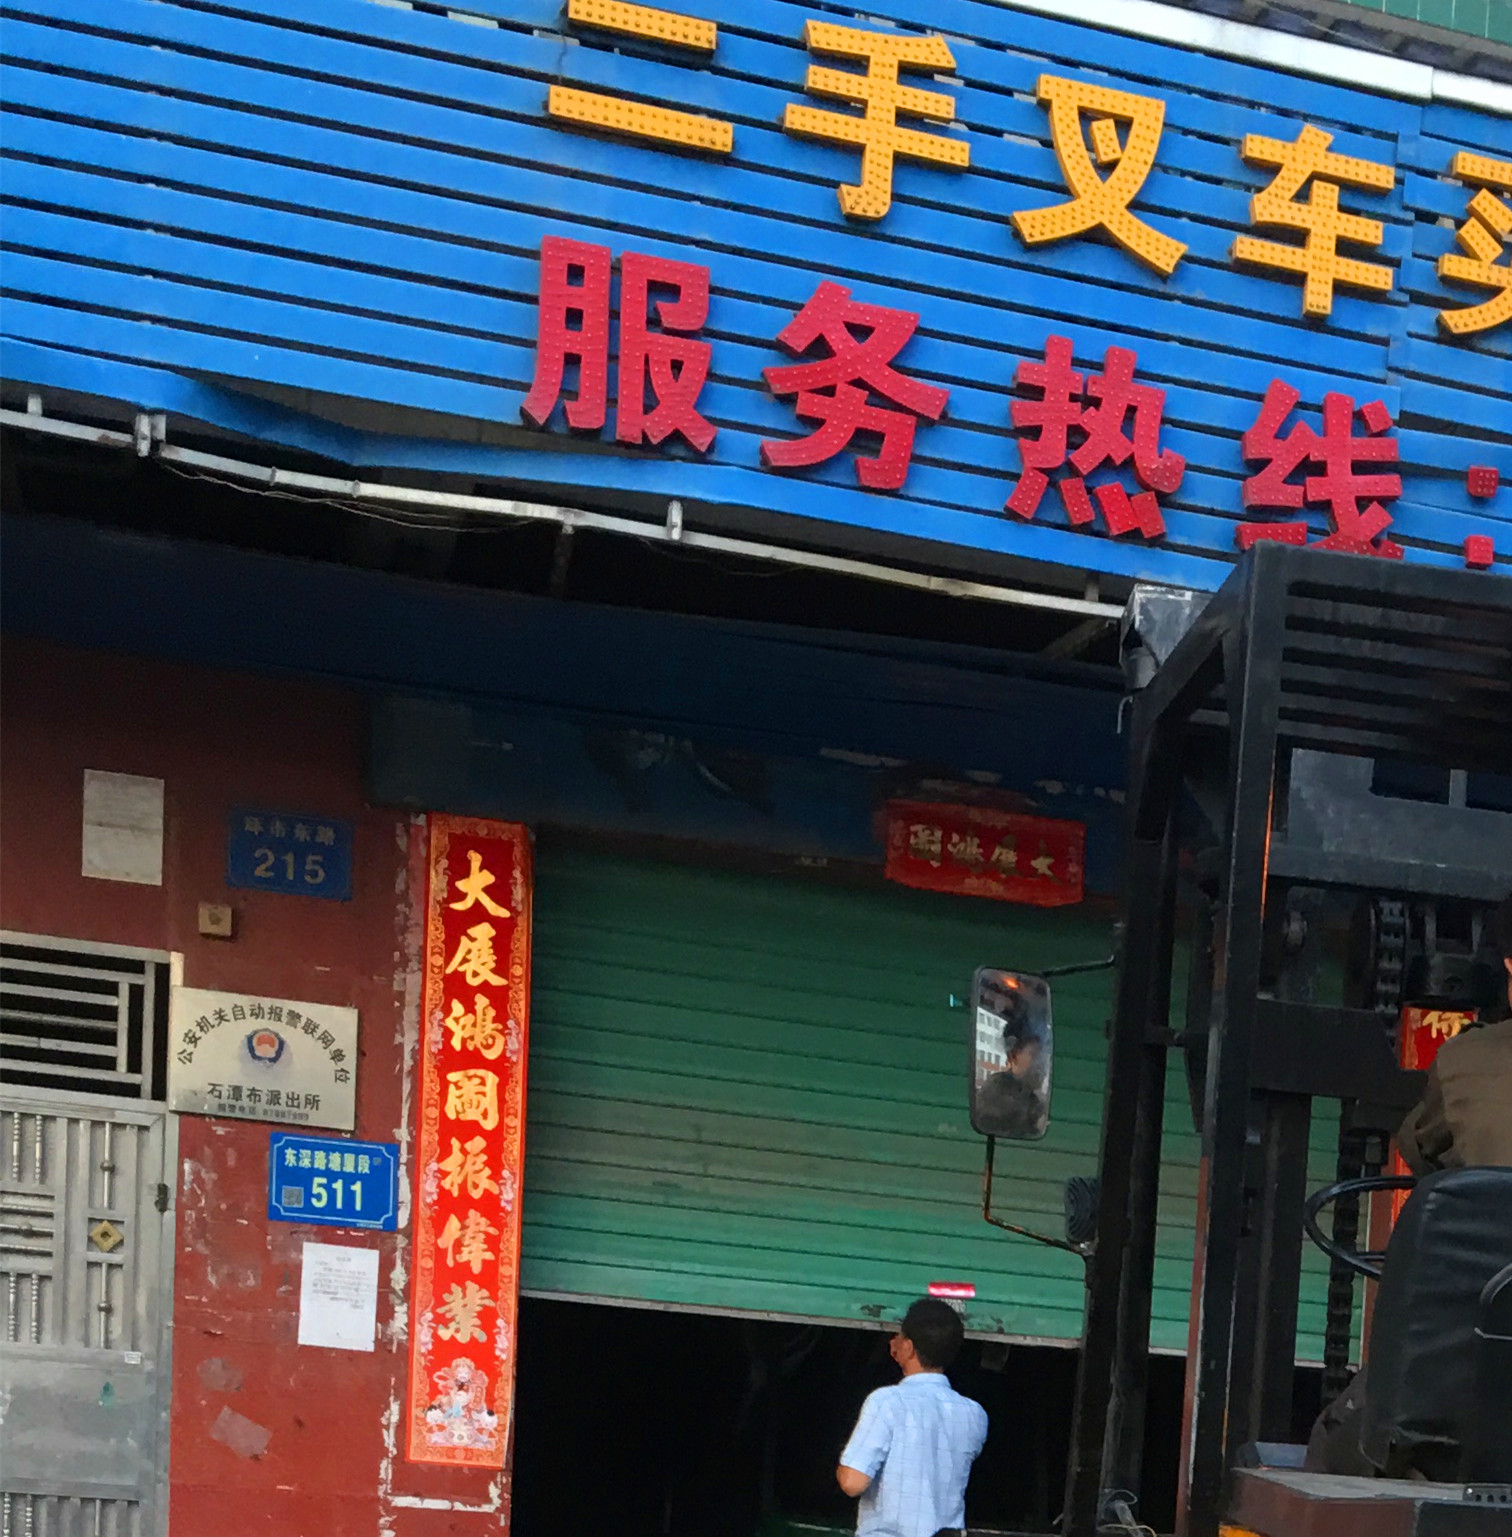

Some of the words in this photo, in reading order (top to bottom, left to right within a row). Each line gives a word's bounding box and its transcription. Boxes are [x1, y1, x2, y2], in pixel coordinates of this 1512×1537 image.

[254, 848, 326, 885] 215
[176, 1002, 351, 1085] 公安机关自动报警联网单位
[206, 1082, 321, 1111] 石潭布派出所
[311, 1177, 362, 1211] 511
